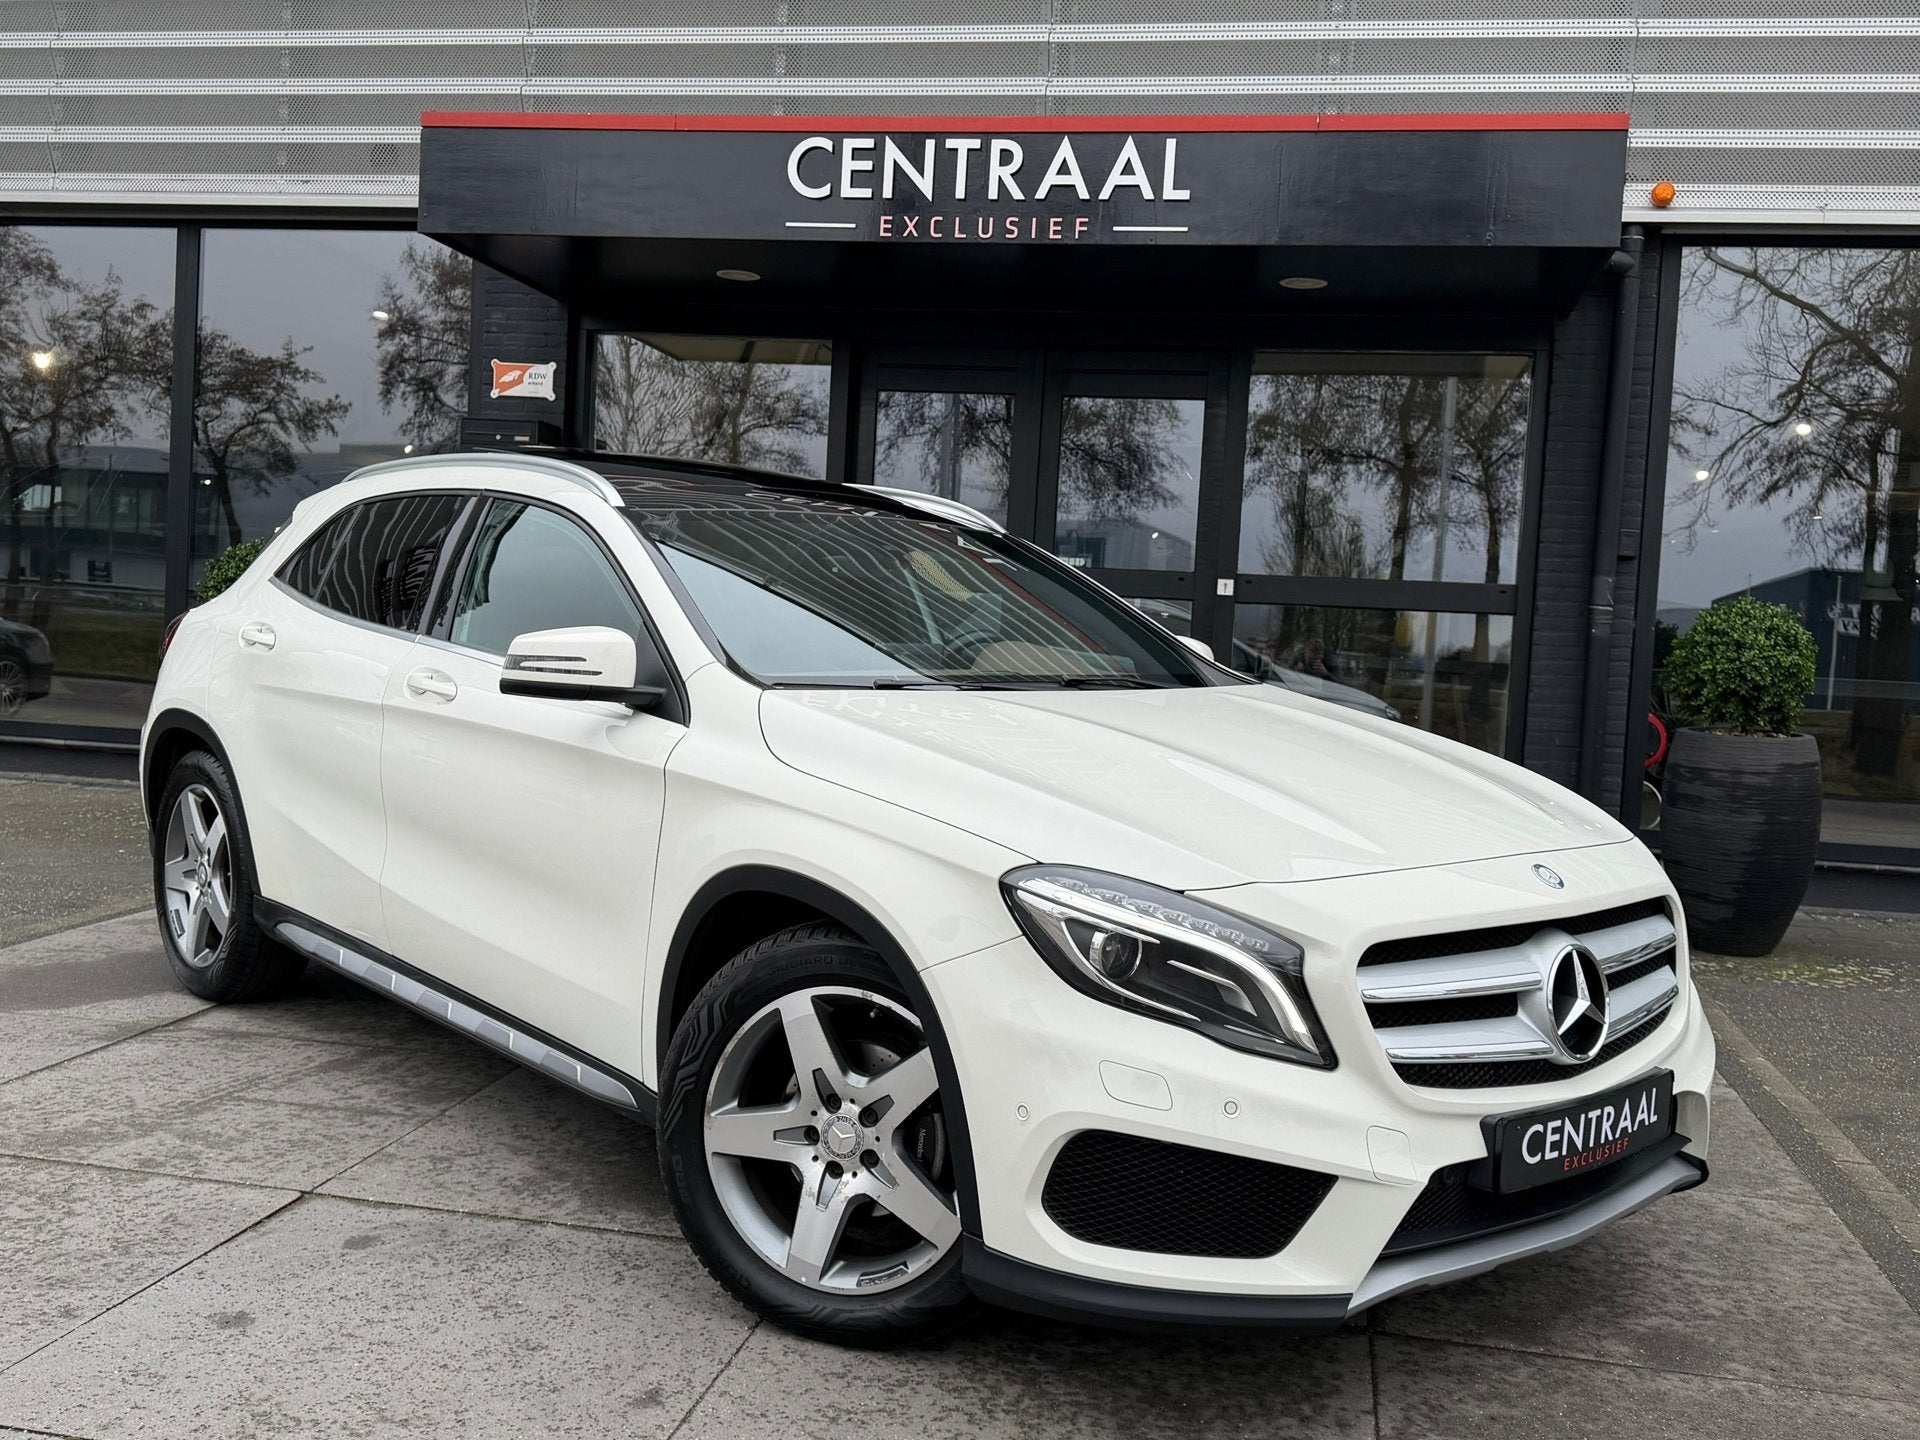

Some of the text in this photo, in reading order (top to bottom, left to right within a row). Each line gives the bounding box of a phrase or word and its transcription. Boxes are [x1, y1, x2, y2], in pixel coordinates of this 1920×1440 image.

[787, 135, 1190, 202] CENTRAAL
[879, 215, 1090, 239] EXCLUSIEF
[528, 372, 548, 380] RDW
[1522, 1088, 1658, 1164] CENTRAAL
[1564, 1137, 1629, 1171] EXCLUSIEF
